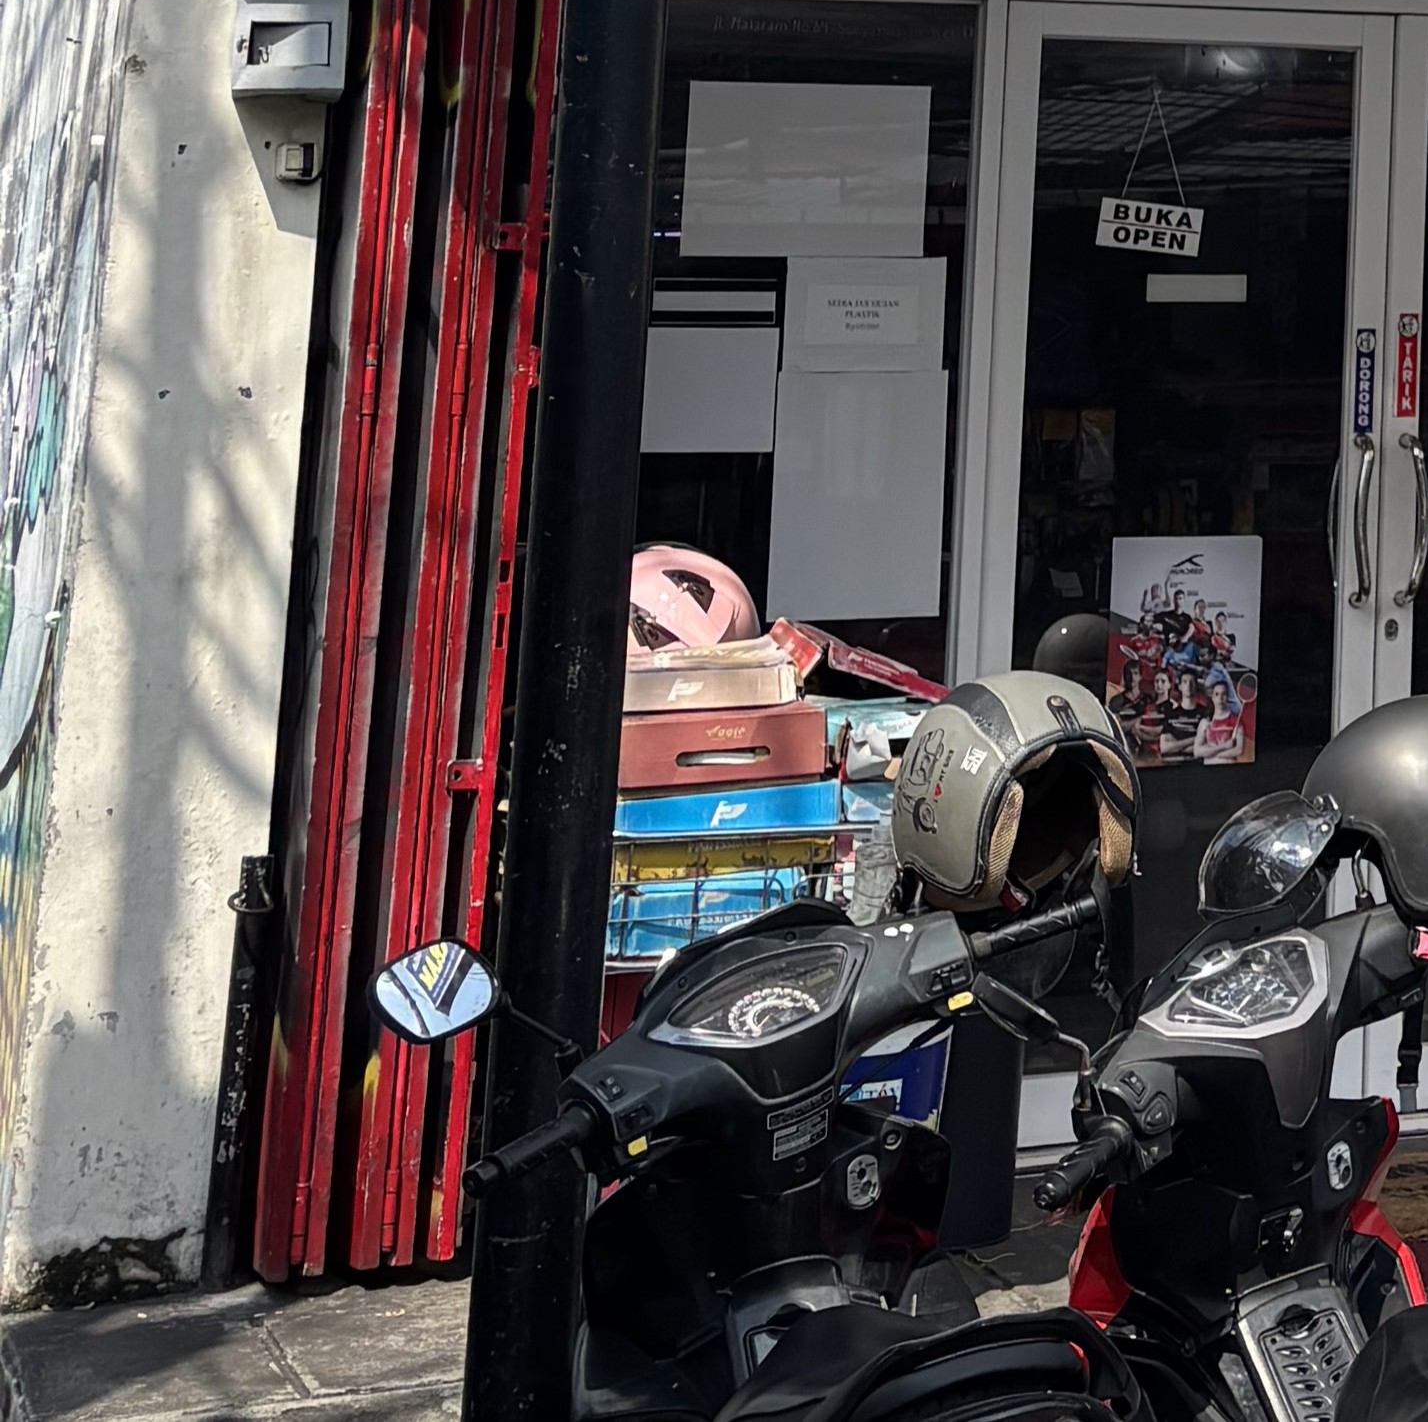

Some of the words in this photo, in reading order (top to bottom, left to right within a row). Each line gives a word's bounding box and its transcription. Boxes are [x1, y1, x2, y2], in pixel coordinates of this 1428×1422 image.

[1113, 203, 1193, 231] BUKA
[1113, 226, 1187, 251] OPEN
[1357, 355, 1371, 427] DORONG
[1400, 341, 1414, 411] TARIK
